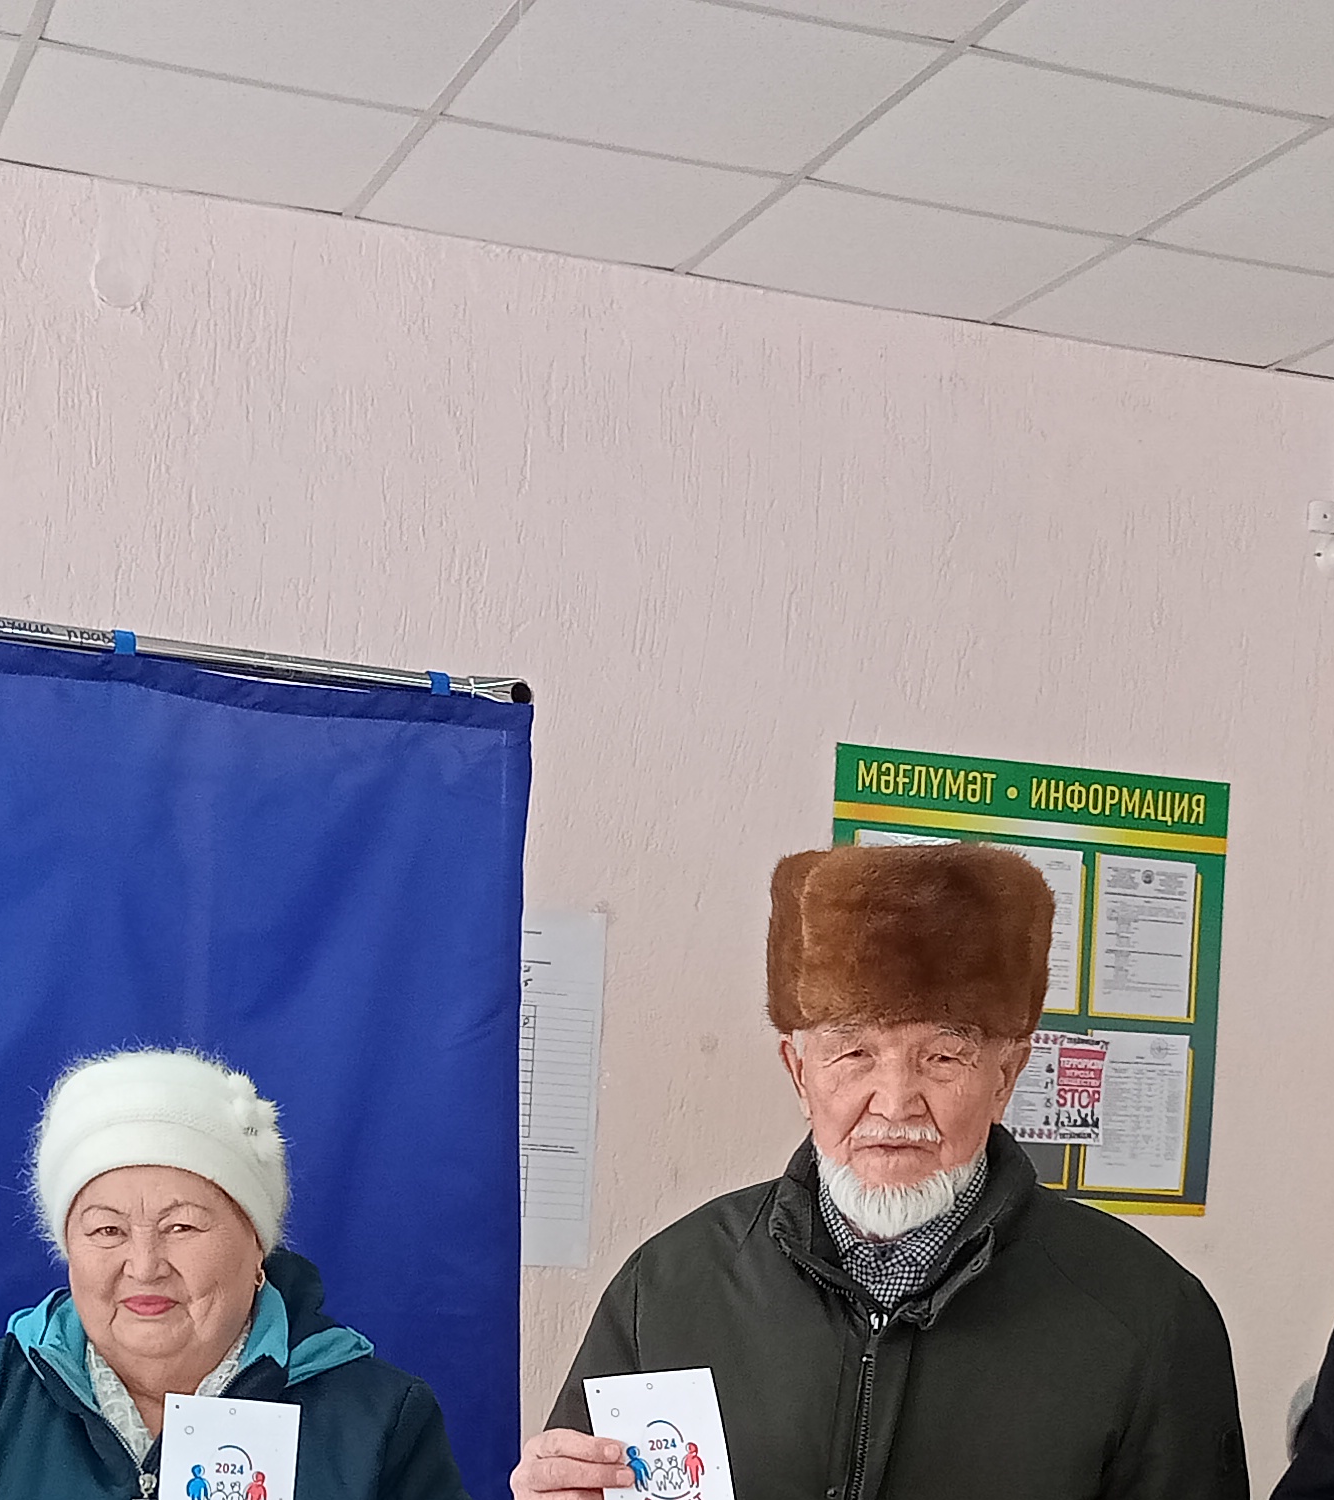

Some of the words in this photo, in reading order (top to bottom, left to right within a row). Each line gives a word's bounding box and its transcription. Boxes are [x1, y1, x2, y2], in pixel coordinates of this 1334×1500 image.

[856, 759, 997, 804] МӘҒЛҮМӘТ
[1029, 777, 1206, 826] ИНФОРМАЦИЯ
[1056, 1087, 1101, 1109] STOP
[648, 1438, 677, 1451] 2024
[215, 1462, 244, 1475] 2024
